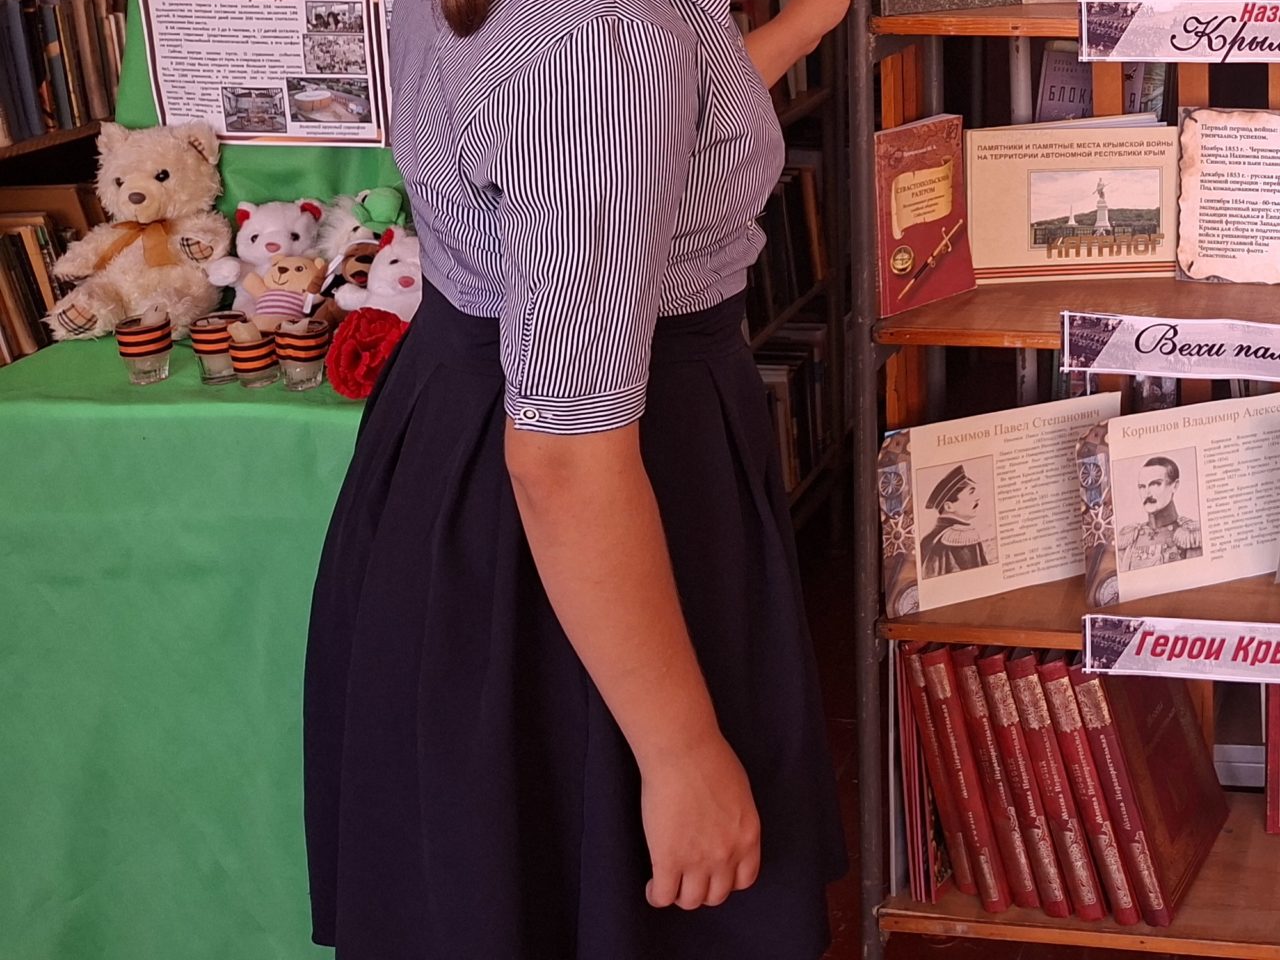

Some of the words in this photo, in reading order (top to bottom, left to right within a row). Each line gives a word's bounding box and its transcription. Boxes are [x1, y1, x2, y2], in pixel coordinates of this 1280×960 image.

[1046, 233, 1165, 259] КАТАЛОГ
[1134, 323, 1227, 358] Вехи
[936, 427, 990, 448] Нахимов
[993, 419, 1029, 437] Павел
[1032, 408, 1100, 429] Степанович
[1122, 420, 1179, 439] Корнилов
[1182, 410, 1240, 429] Владимир
[1134, 629, 1226, 661] Герои
